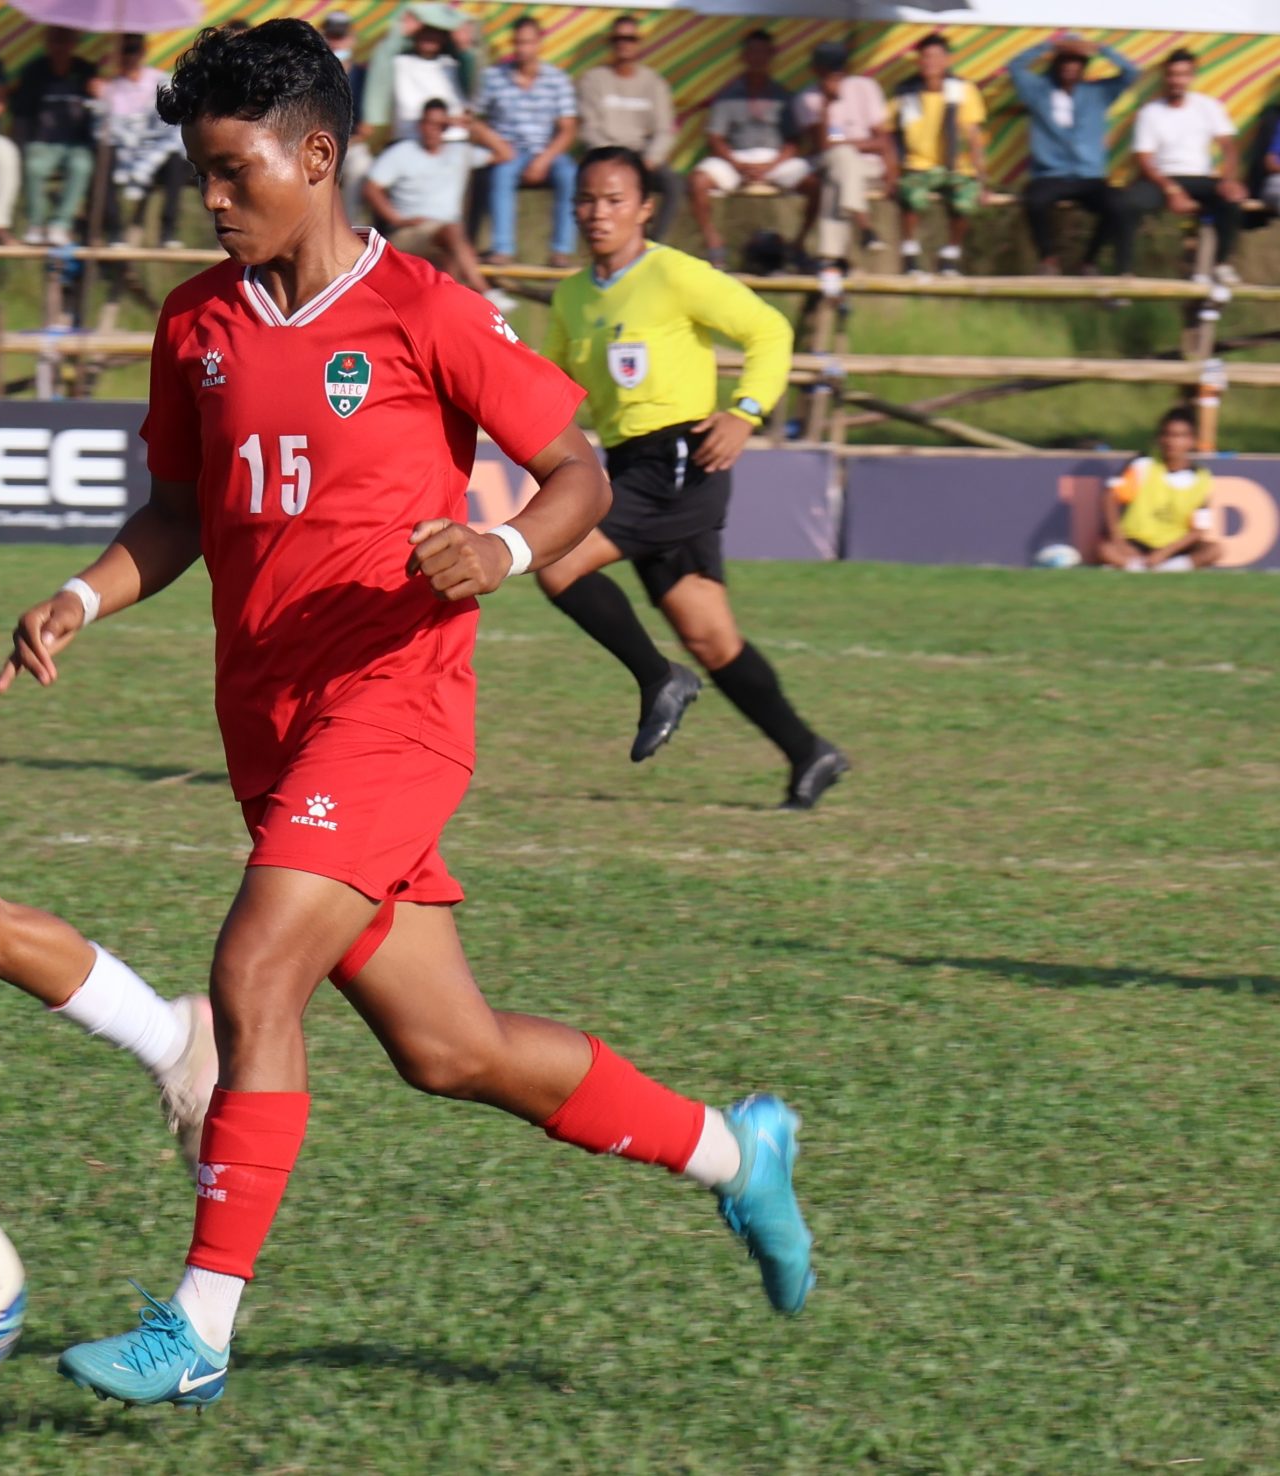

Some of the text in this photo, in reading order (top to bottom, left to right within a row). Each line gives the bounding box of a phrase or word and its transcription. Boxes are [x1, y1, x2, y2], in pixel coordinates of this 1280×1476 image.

[202, 374, 227, 388] KELME
[332, 383, 362, 396] TAFC
[238, 433, 312, 516] 15
[290, 815, 338, 831] KELME
